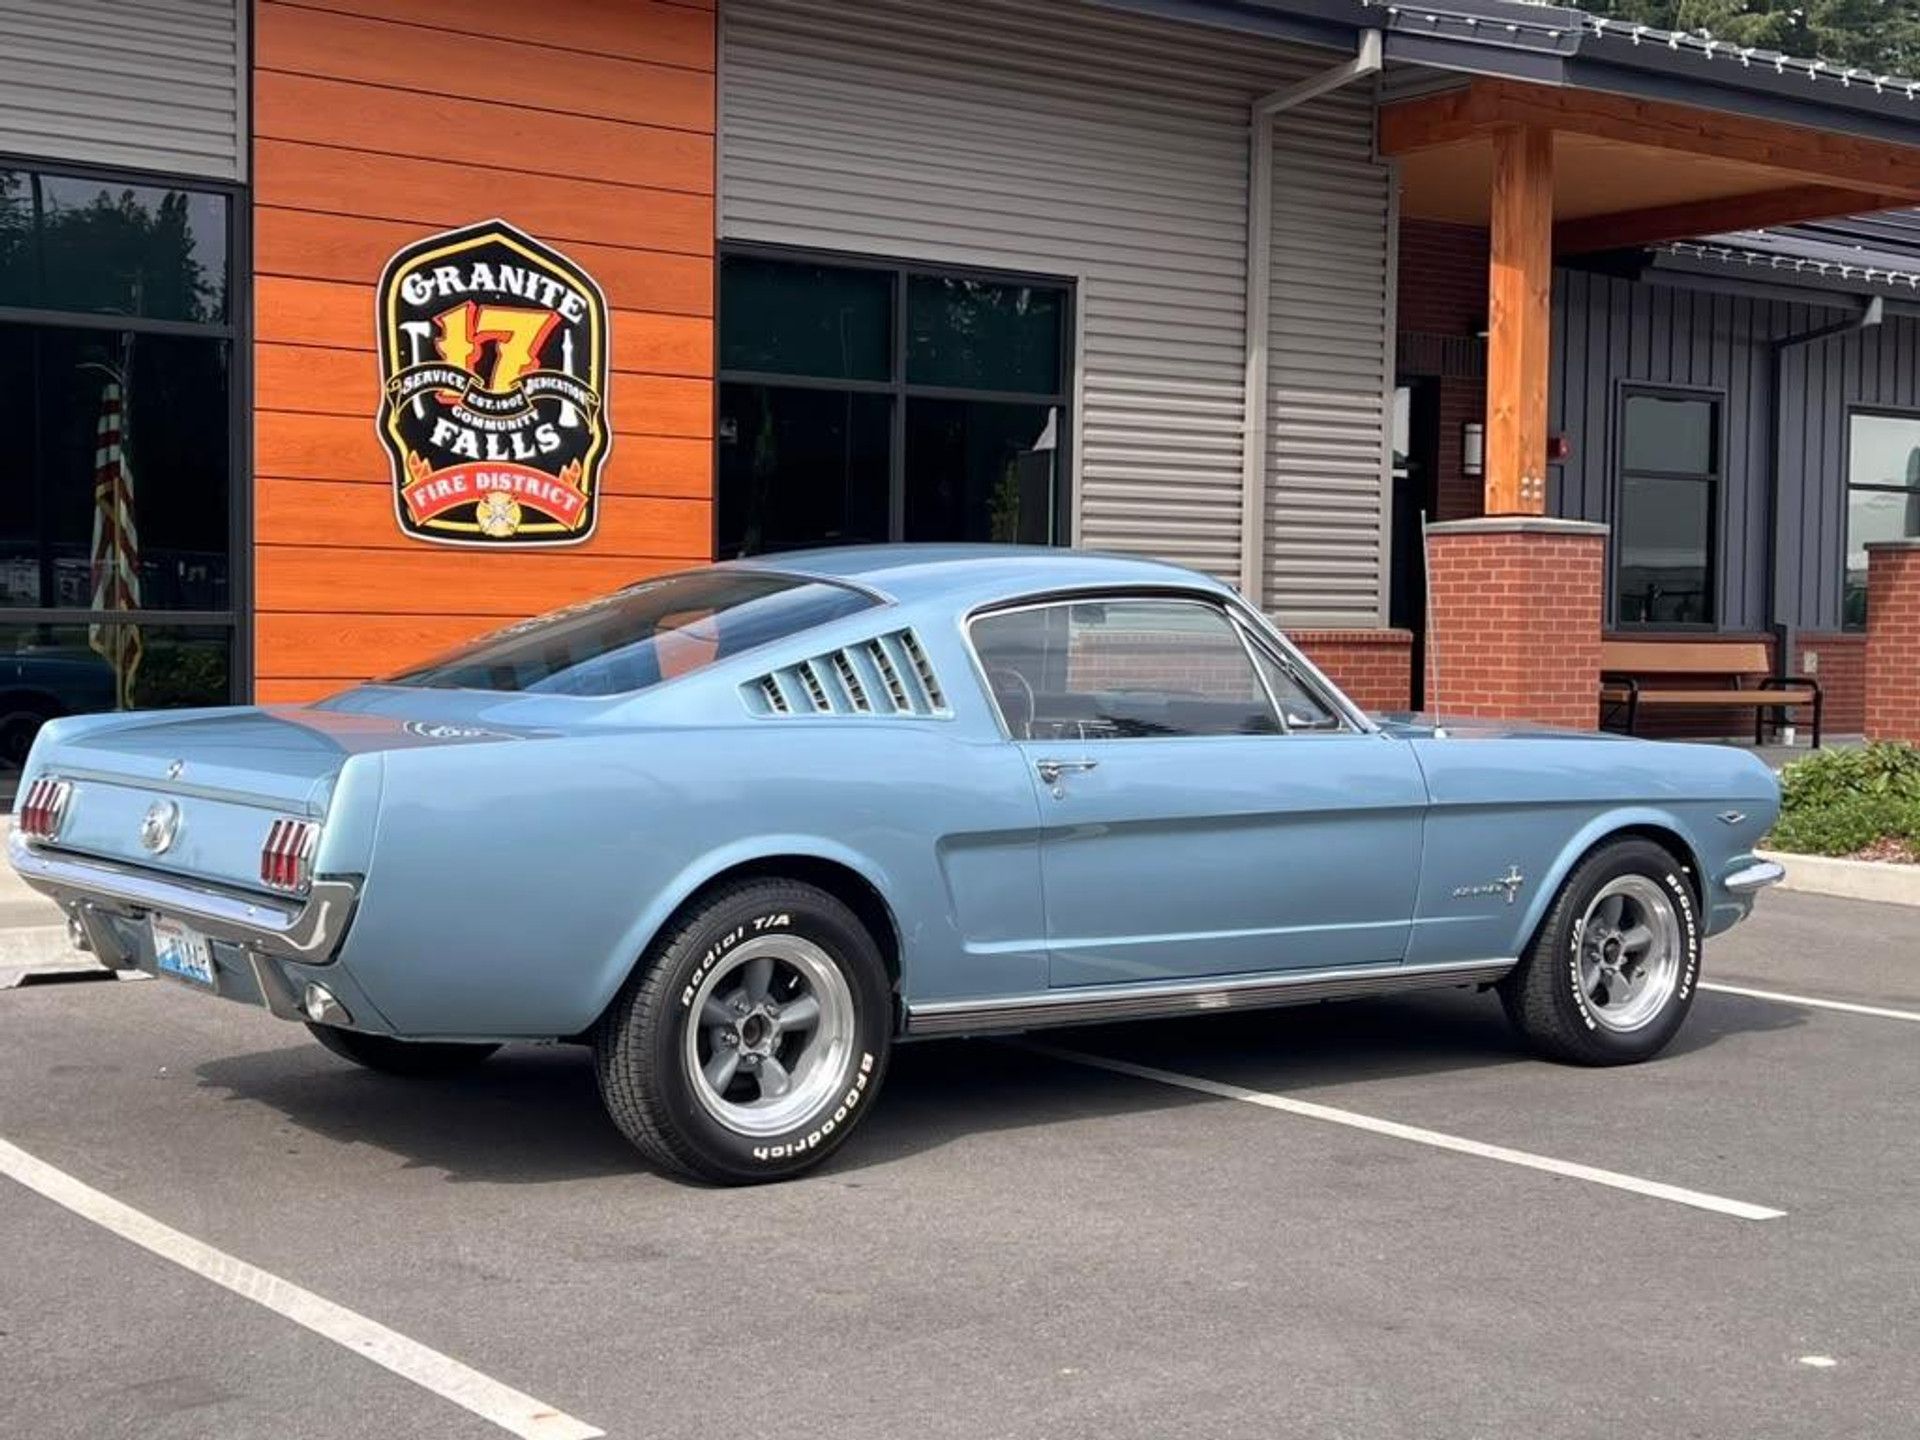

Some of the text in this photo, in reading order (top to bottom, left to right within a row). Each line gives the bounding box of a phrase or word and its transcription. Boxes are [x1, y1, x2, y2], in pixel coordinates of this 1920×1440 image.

[401, 263, 587, 323] GRANITE
[433, 299, 562, 404] 17
[403, 370, 465, 394] SERVICE
[429, 417, 561, 460] FALLS
[452, 405, 539, 430] COMMUNITY
[413, 472, 577, 511] FIRE DISTRICT
[681, 914, 791, 1007] Radial T/A
[1666, 874, 1696, 999] BFGoodrich
[753, 1052, 874, 1159] BFGoodrich
